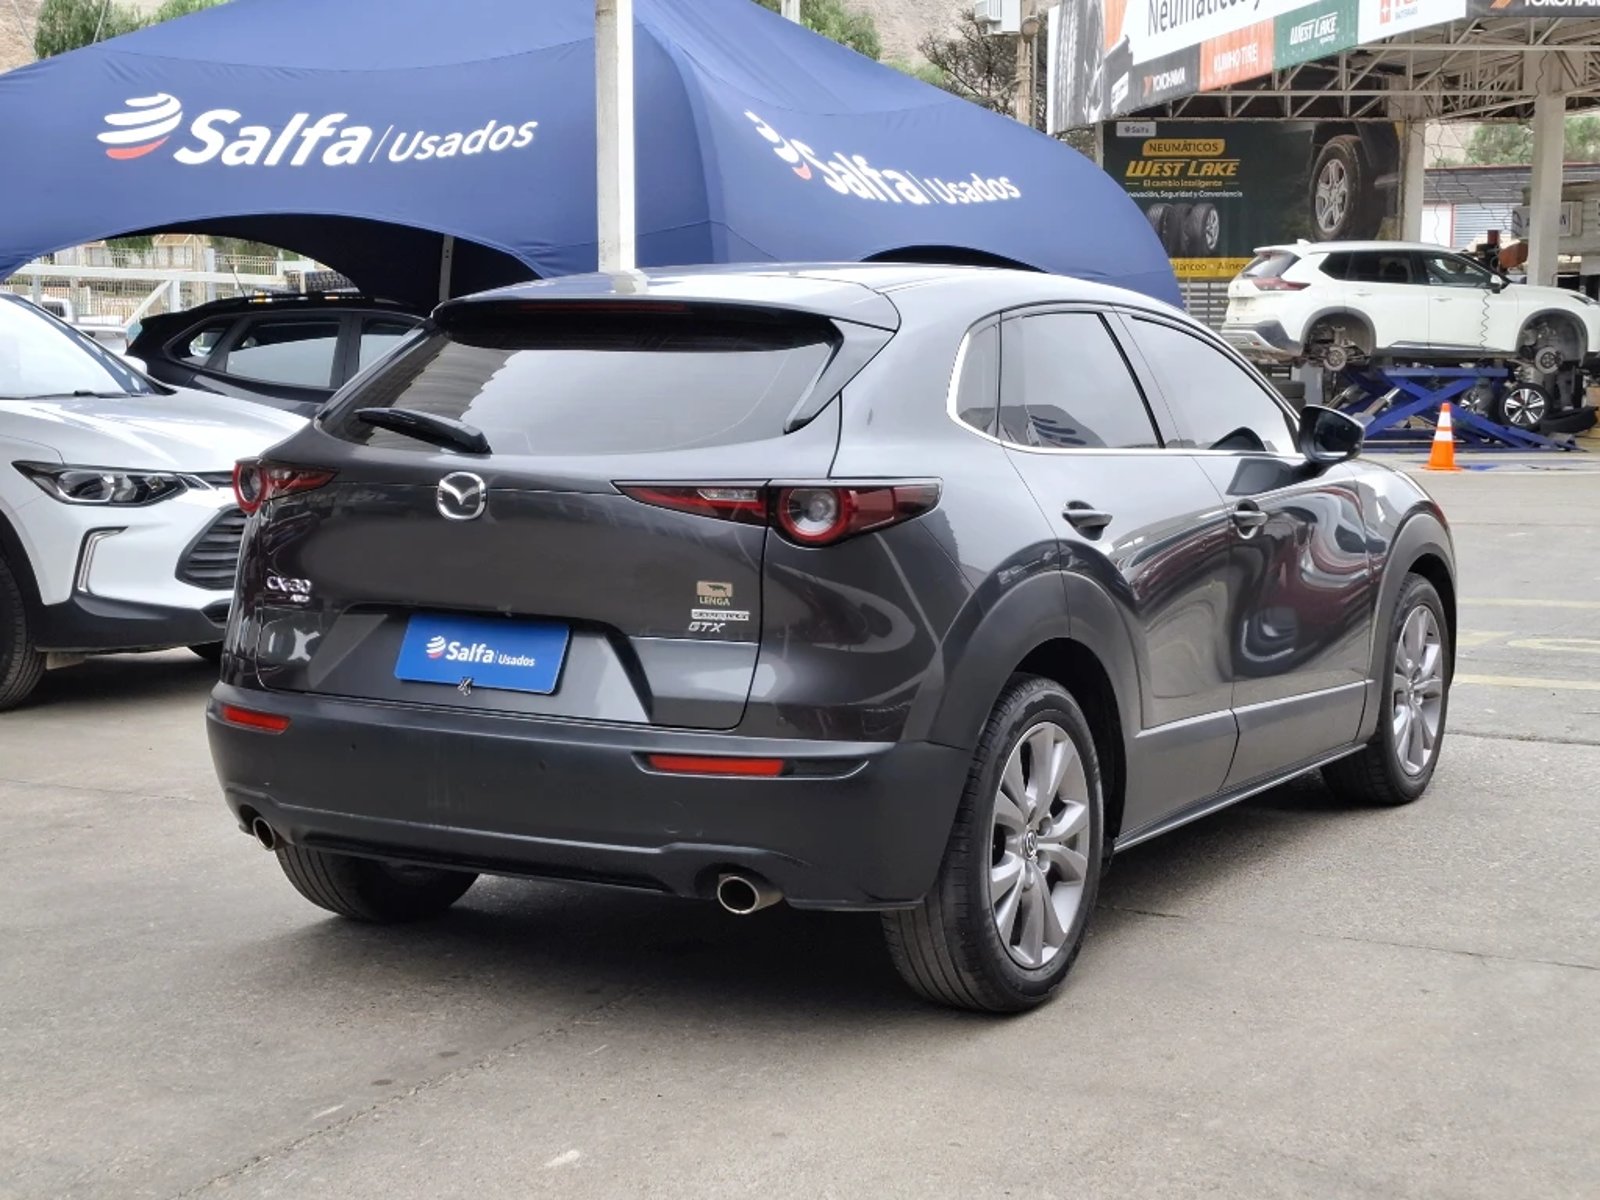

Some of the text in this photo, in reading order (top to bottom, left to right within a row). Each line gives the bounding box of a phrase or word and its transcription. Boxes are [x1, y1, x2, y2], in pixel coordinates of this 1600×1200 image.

[1290, 21, 1315, 45] WEST
[1314, 13, 1338, 38] LAKE
[174, 108, 538, 166] Salfa Usados
[1149, 140, 1219, 152] NEUMÁTICOS
[790, 138, 1021, 205] Salfa Usados
[1125, 160, 1240, 177] WEST LAKE
[688, 621, 726, 633] GTX
[446, 641, 535, 667] Salfa Usados
